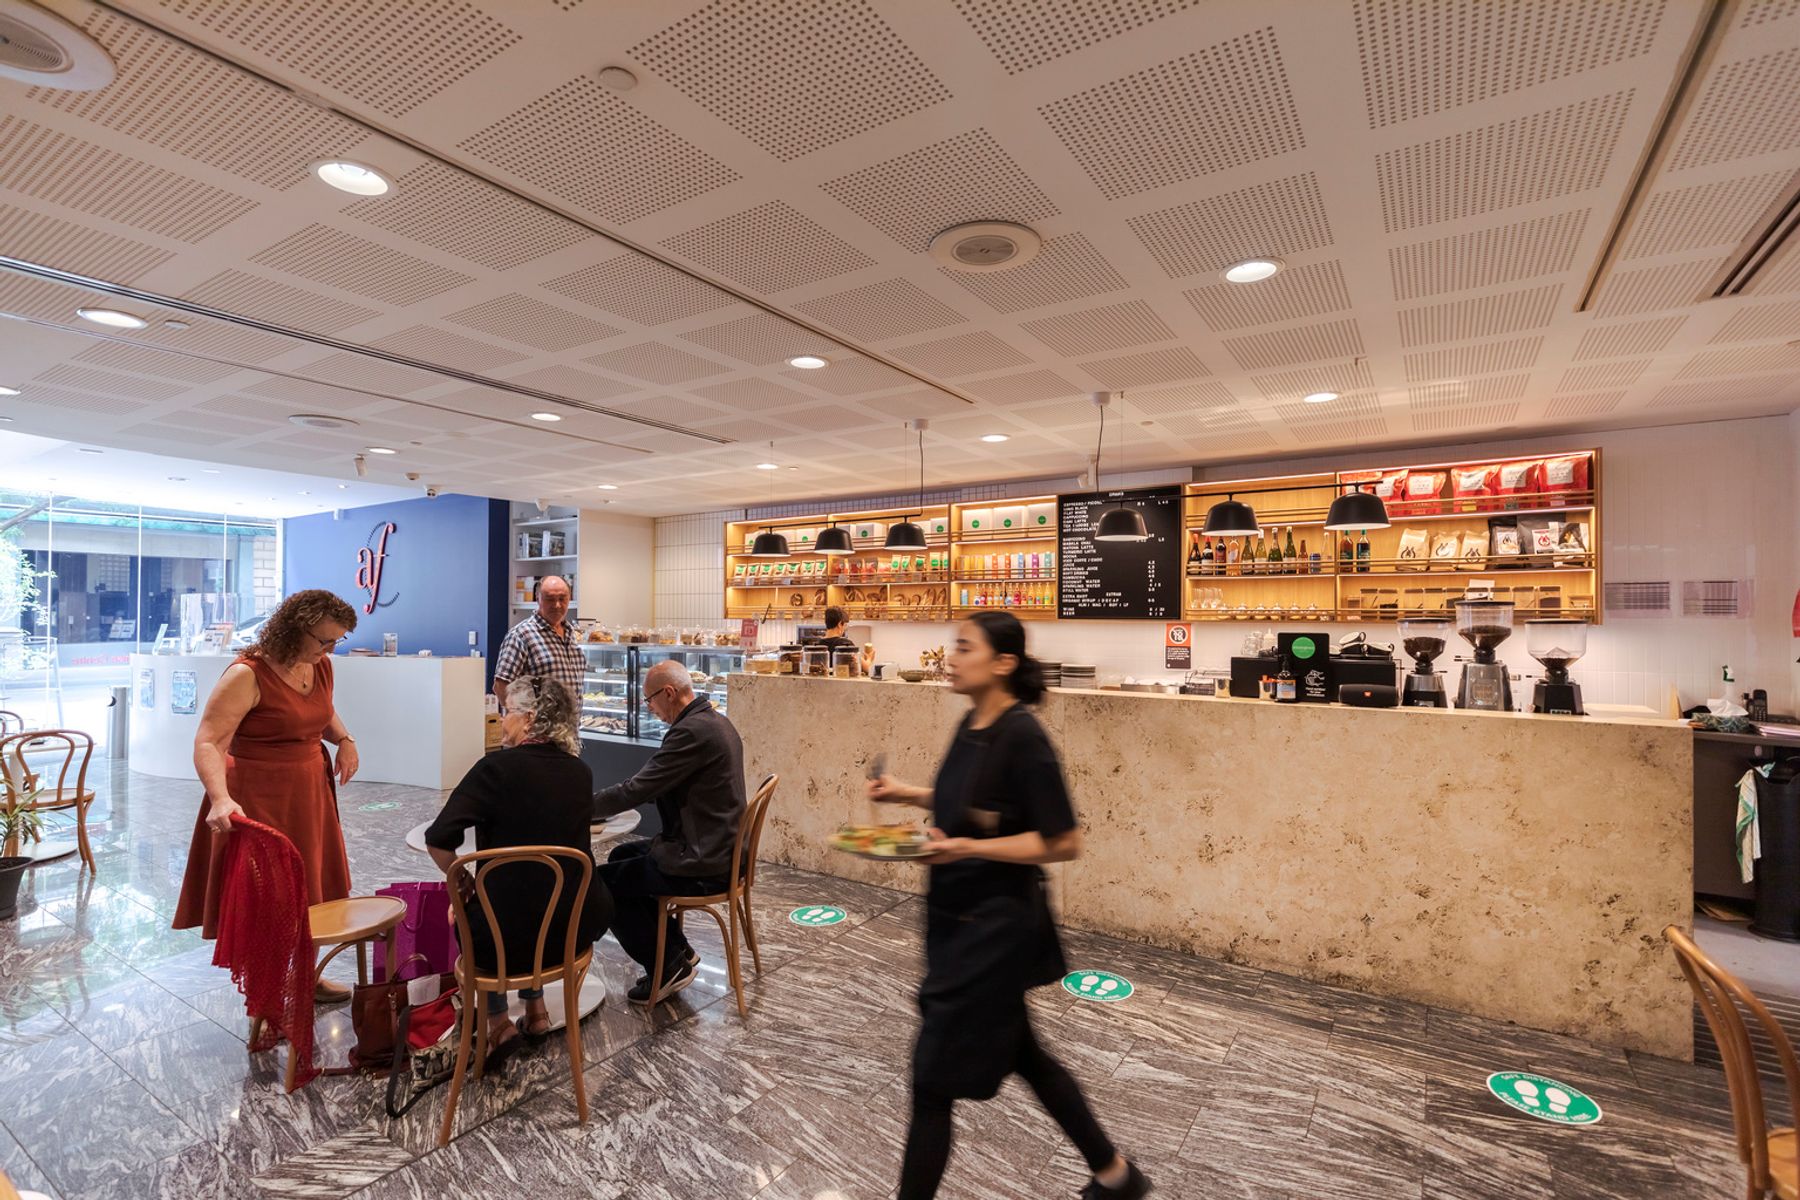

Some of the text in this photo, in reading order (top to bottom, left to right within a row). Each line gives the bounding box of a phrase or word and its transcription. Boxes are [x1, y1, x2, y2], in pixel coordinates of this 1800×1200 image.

[1522, 1074, 1581, 1098] DISTANCING
[1499, 1091, 1531, 1111] PLEASE
[1532, 1109, 1570, 1121] STAND
